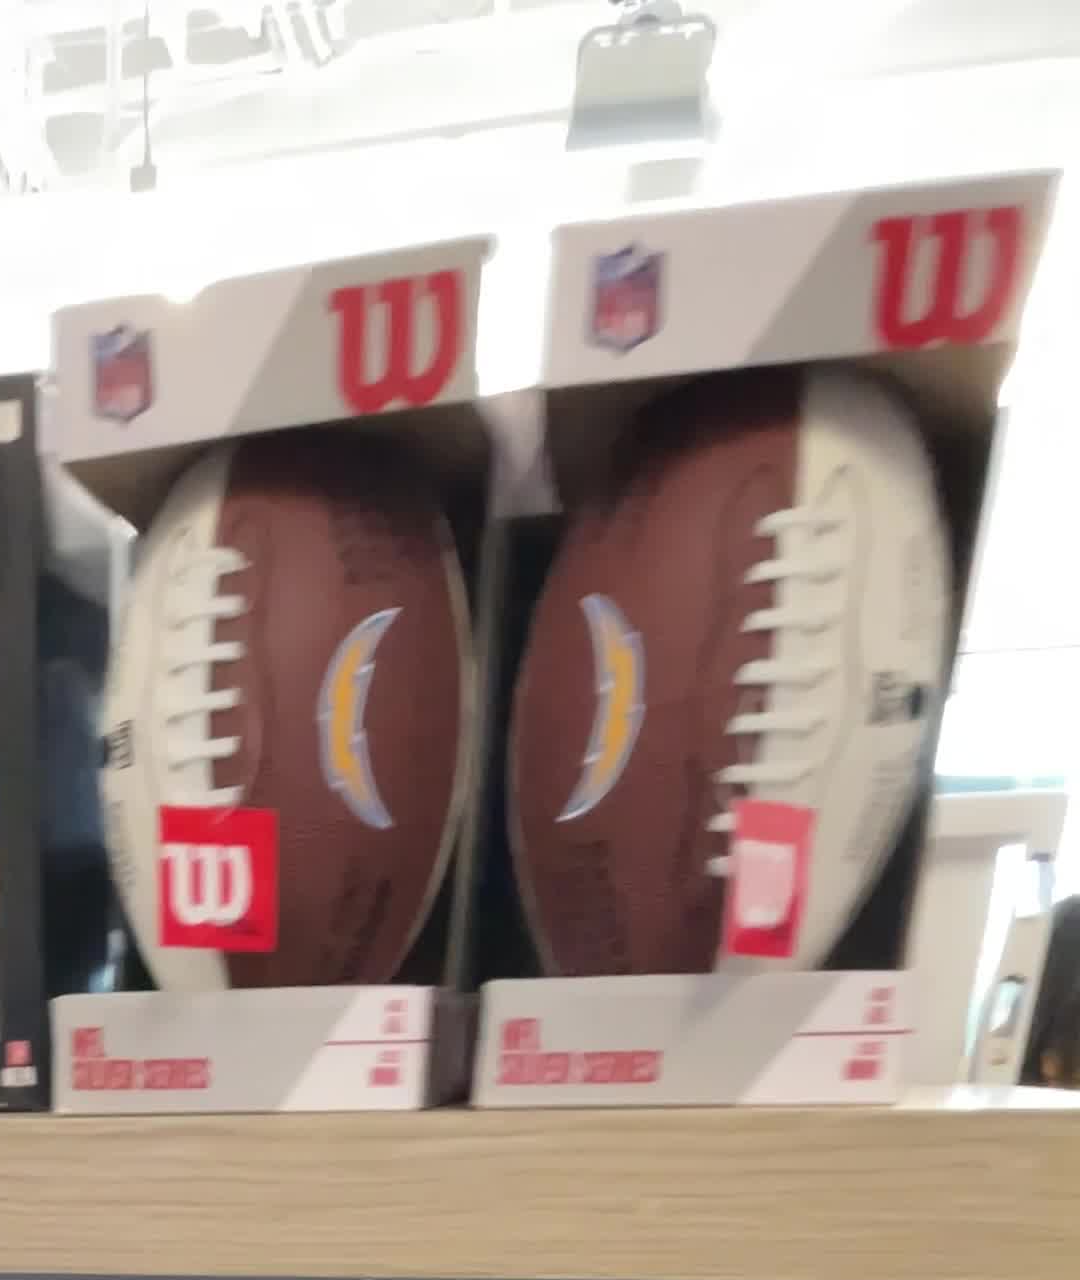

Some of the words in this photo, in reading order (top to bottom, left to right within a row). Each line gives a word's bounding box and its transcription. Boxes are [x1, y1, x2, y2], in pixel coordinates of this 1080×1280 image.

[328, 268, 466, 417] W
[867, 206, 1026, 351] W
[161, 843, 254, 927] W
